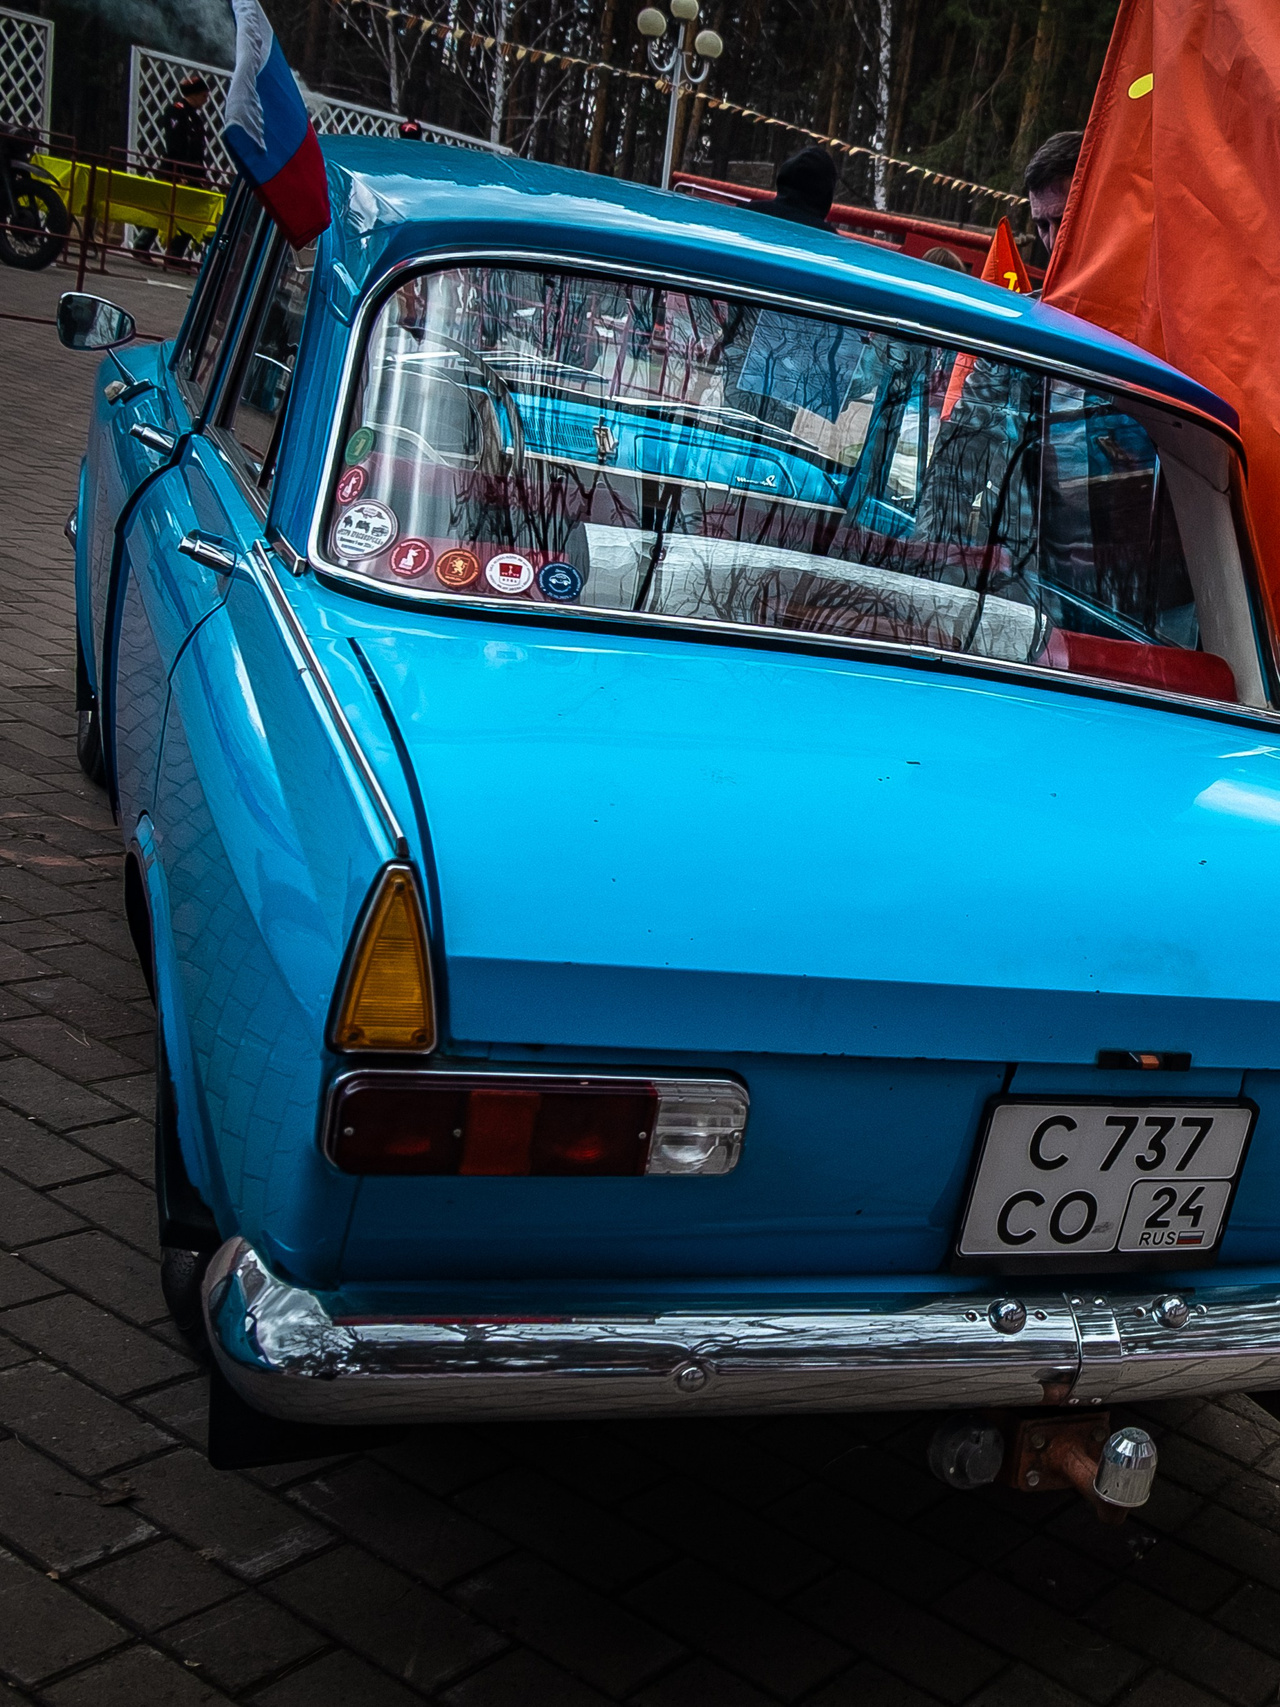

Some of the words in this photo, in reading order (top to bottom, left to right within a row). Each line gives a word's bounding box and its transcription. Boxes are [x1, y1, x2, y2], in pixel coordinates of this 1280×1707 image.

[1029, 1115, 1078, 1171] С
[1098, 1115, 1214, 1172] 737
[997, 1189, 1099, 1246] СО
[1144, 1186, 1206, 1229] 24
[1138, 1231, 1177, 1246] RUS
